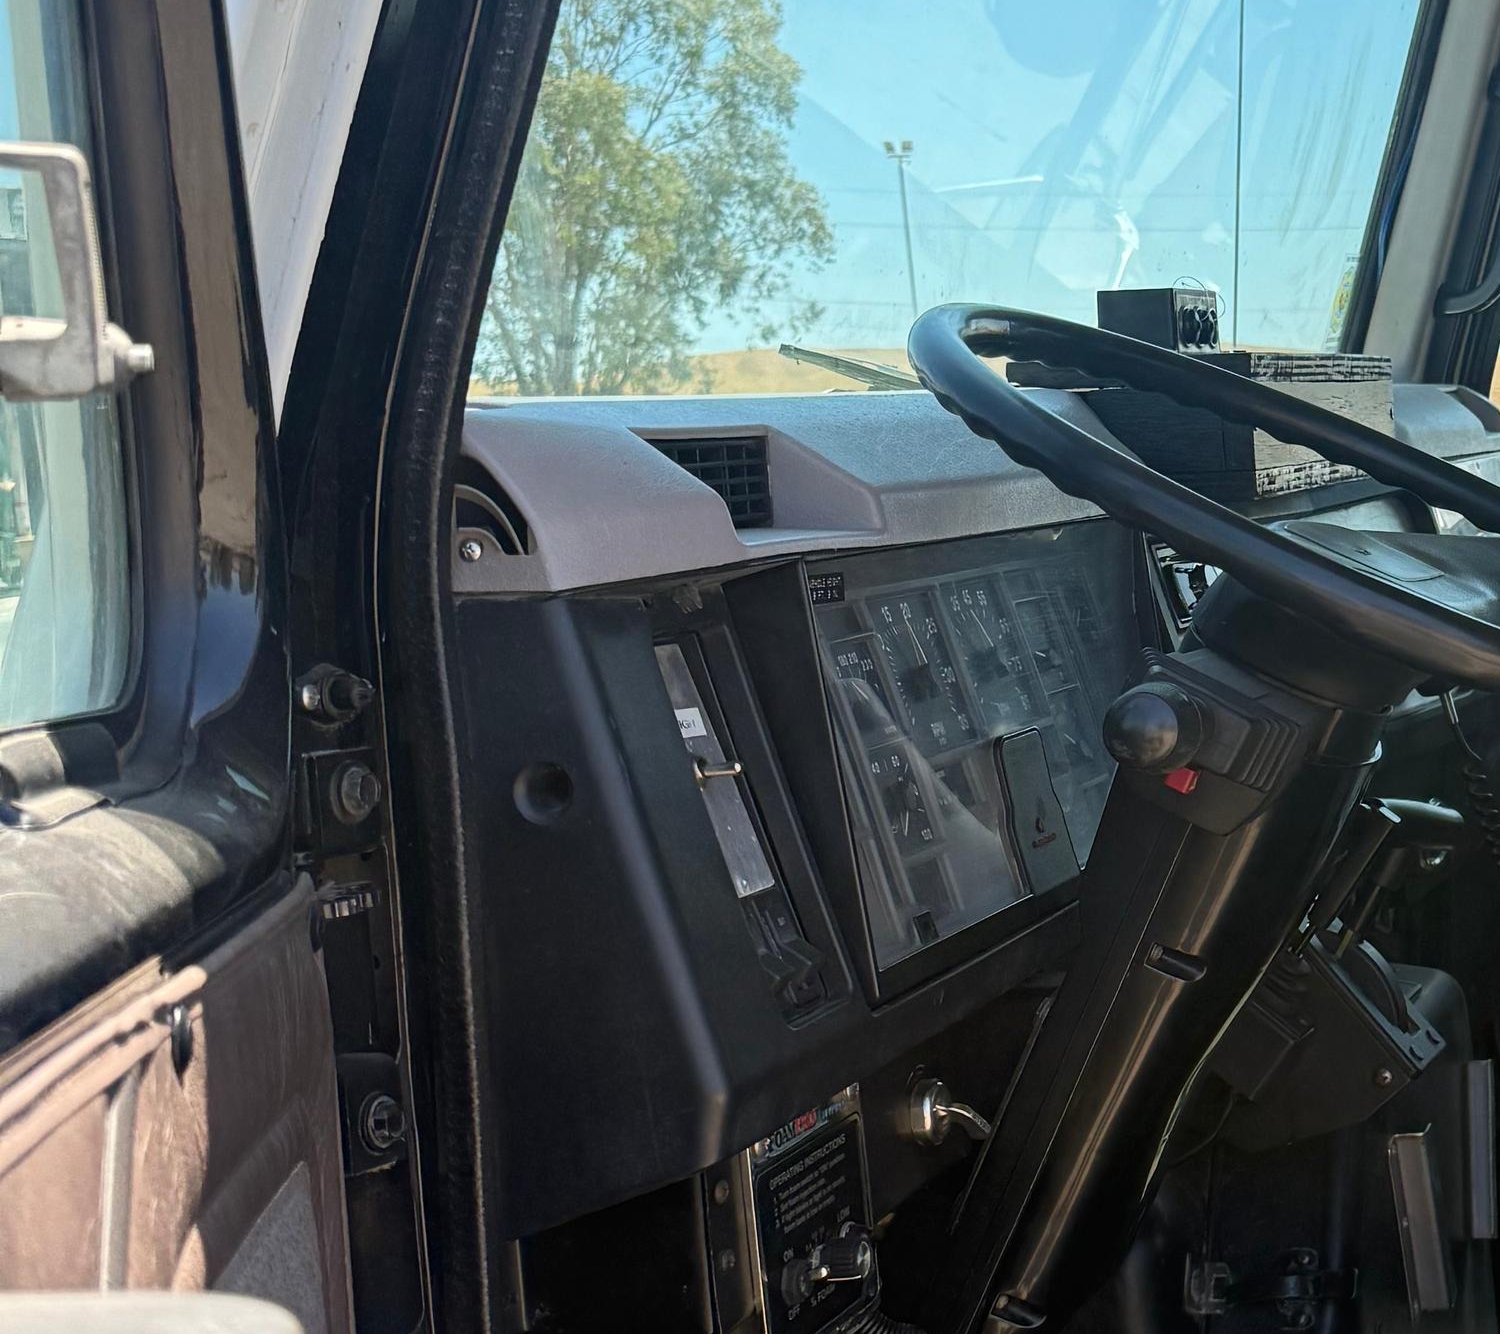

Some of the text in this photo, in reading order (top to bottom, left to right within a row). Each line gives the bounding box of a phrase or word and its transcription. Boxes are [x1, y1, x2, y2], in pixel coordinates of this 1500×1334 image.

[769, 1131, 847, 1191] OPERATING INSTRUCTIONS
[837, 1205, 851, 1223] LOW
[787, 1302, 801, 1321] OFF
